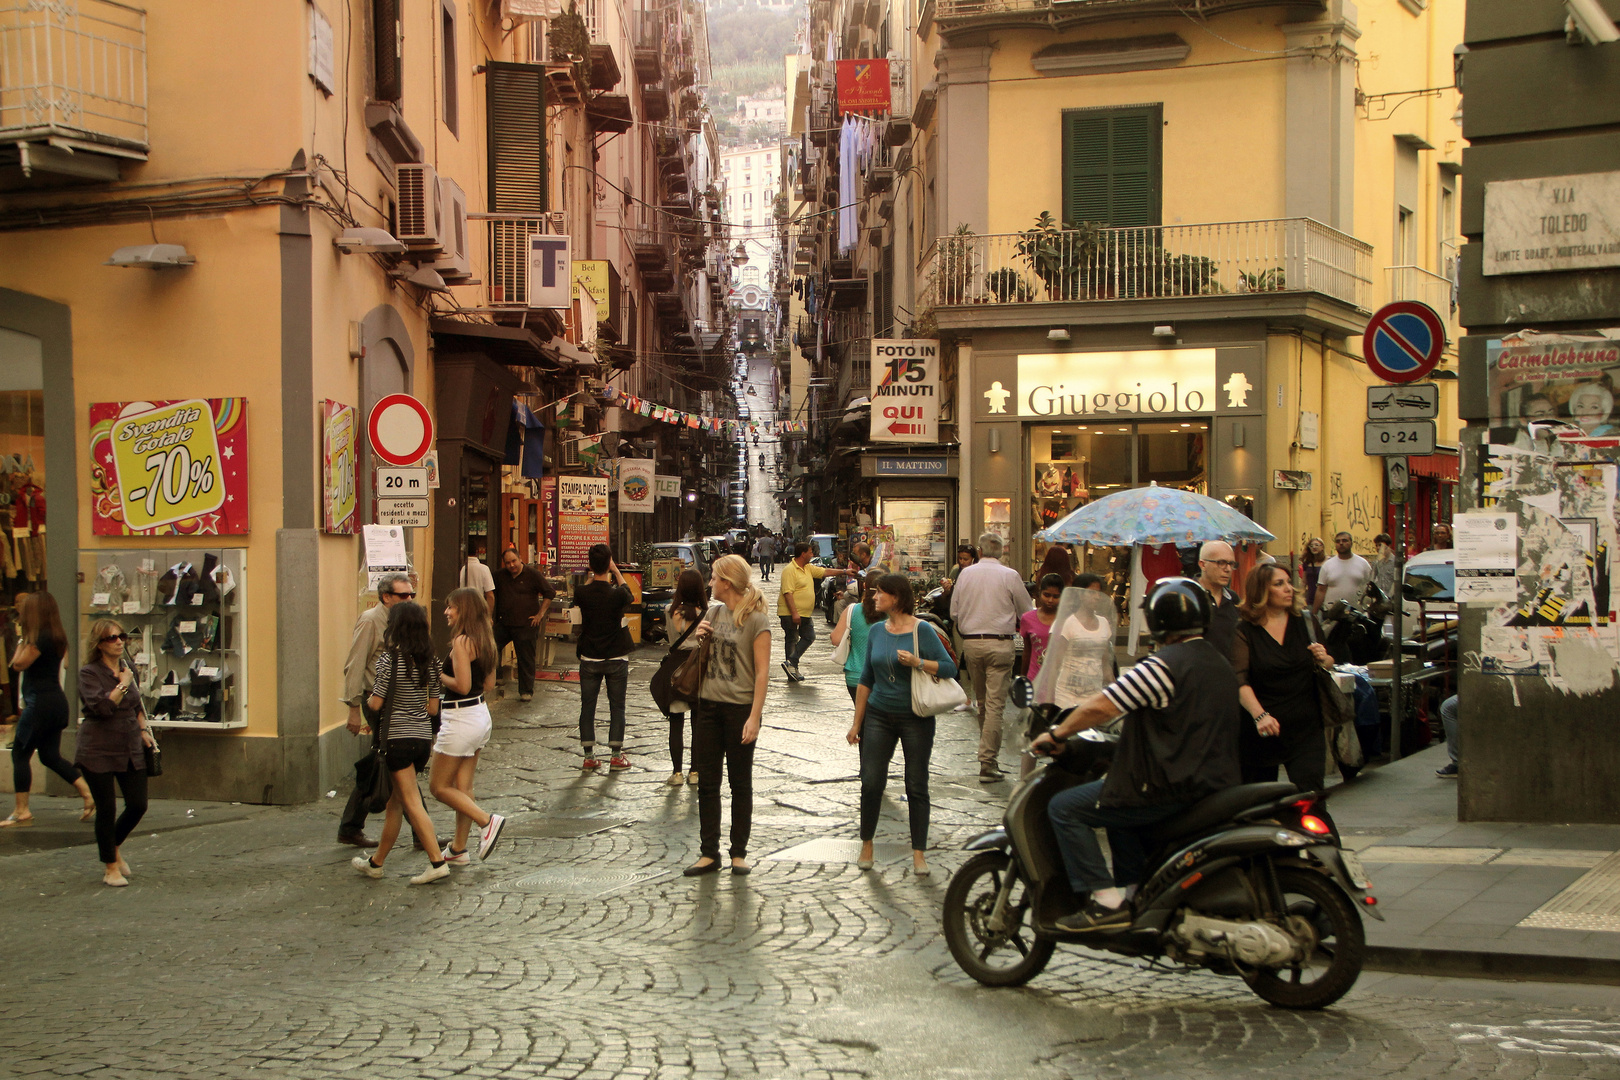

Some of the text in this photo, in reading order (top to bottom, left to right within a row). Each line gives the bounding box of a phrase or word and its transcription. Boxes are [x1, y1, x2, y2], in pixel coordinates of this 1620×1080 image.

[1553, 187, 1575, 204] VIA
[1540, 213, 1587, 235] TOLEDO
[1495, 249, 1520, 262] LIMITE
[532, 240, 567, 288] T
[581, 263, 596, 271] Bed
[876, 346, 936, 357] FOTO IN
[1497, 345, 1618, 370] Carmelobruna
[885, 358, 926, 383] 15
[876, 385, 934, 397] MINUTI
[1028, 381, 1205, 416] Giuggiolo
[882, 406, 923, 420] QUI
[118, 406, 201, 441] Svendita
[133, 425, 194, 455] Totale
[881, 461, 943, 470] IL MATTINO
[129, 443, 214, 517] -70%
[385, 476, 420, 488] 20 m
[655, 479, 679, 492] TLET
[561, 482, 607, 496] STAMPA DIGITALE
[380, 508, 405, 517] residenti
[412, 509, 428, 517] mezzi
[390, 517, 419, 525] di servizio
